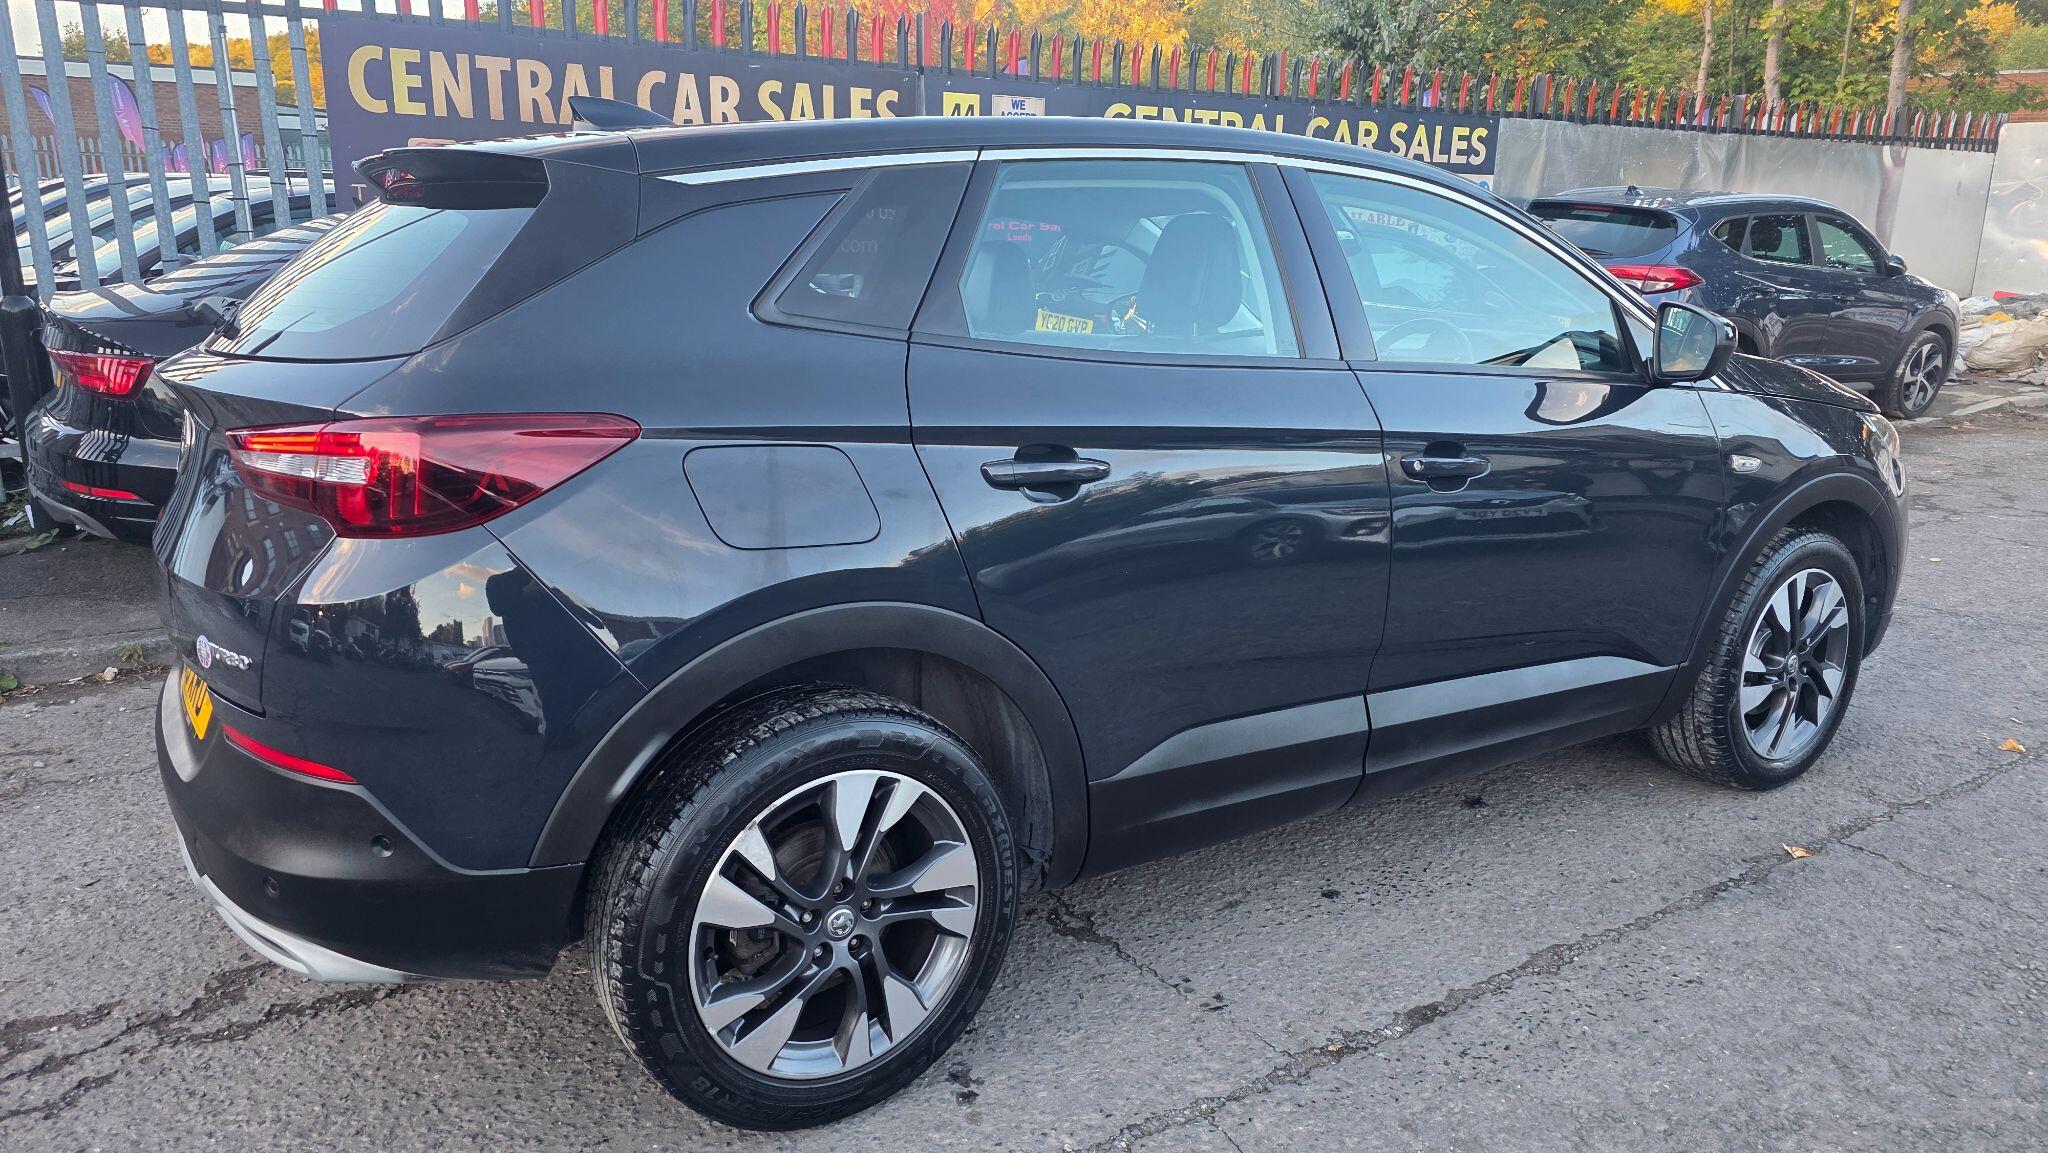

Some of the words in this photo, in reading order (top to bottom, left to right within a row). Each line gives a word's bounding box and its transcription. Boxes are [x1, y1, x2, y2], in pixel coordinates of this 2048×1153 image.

[636, 70, 741, 125] CAR
[1011, 99, 1026, 110] WE
[1389, 121, 1489, 166] SALES
[1008, 221, 1035, 231] Car
[1041, 312, 1065, 331] YC20
